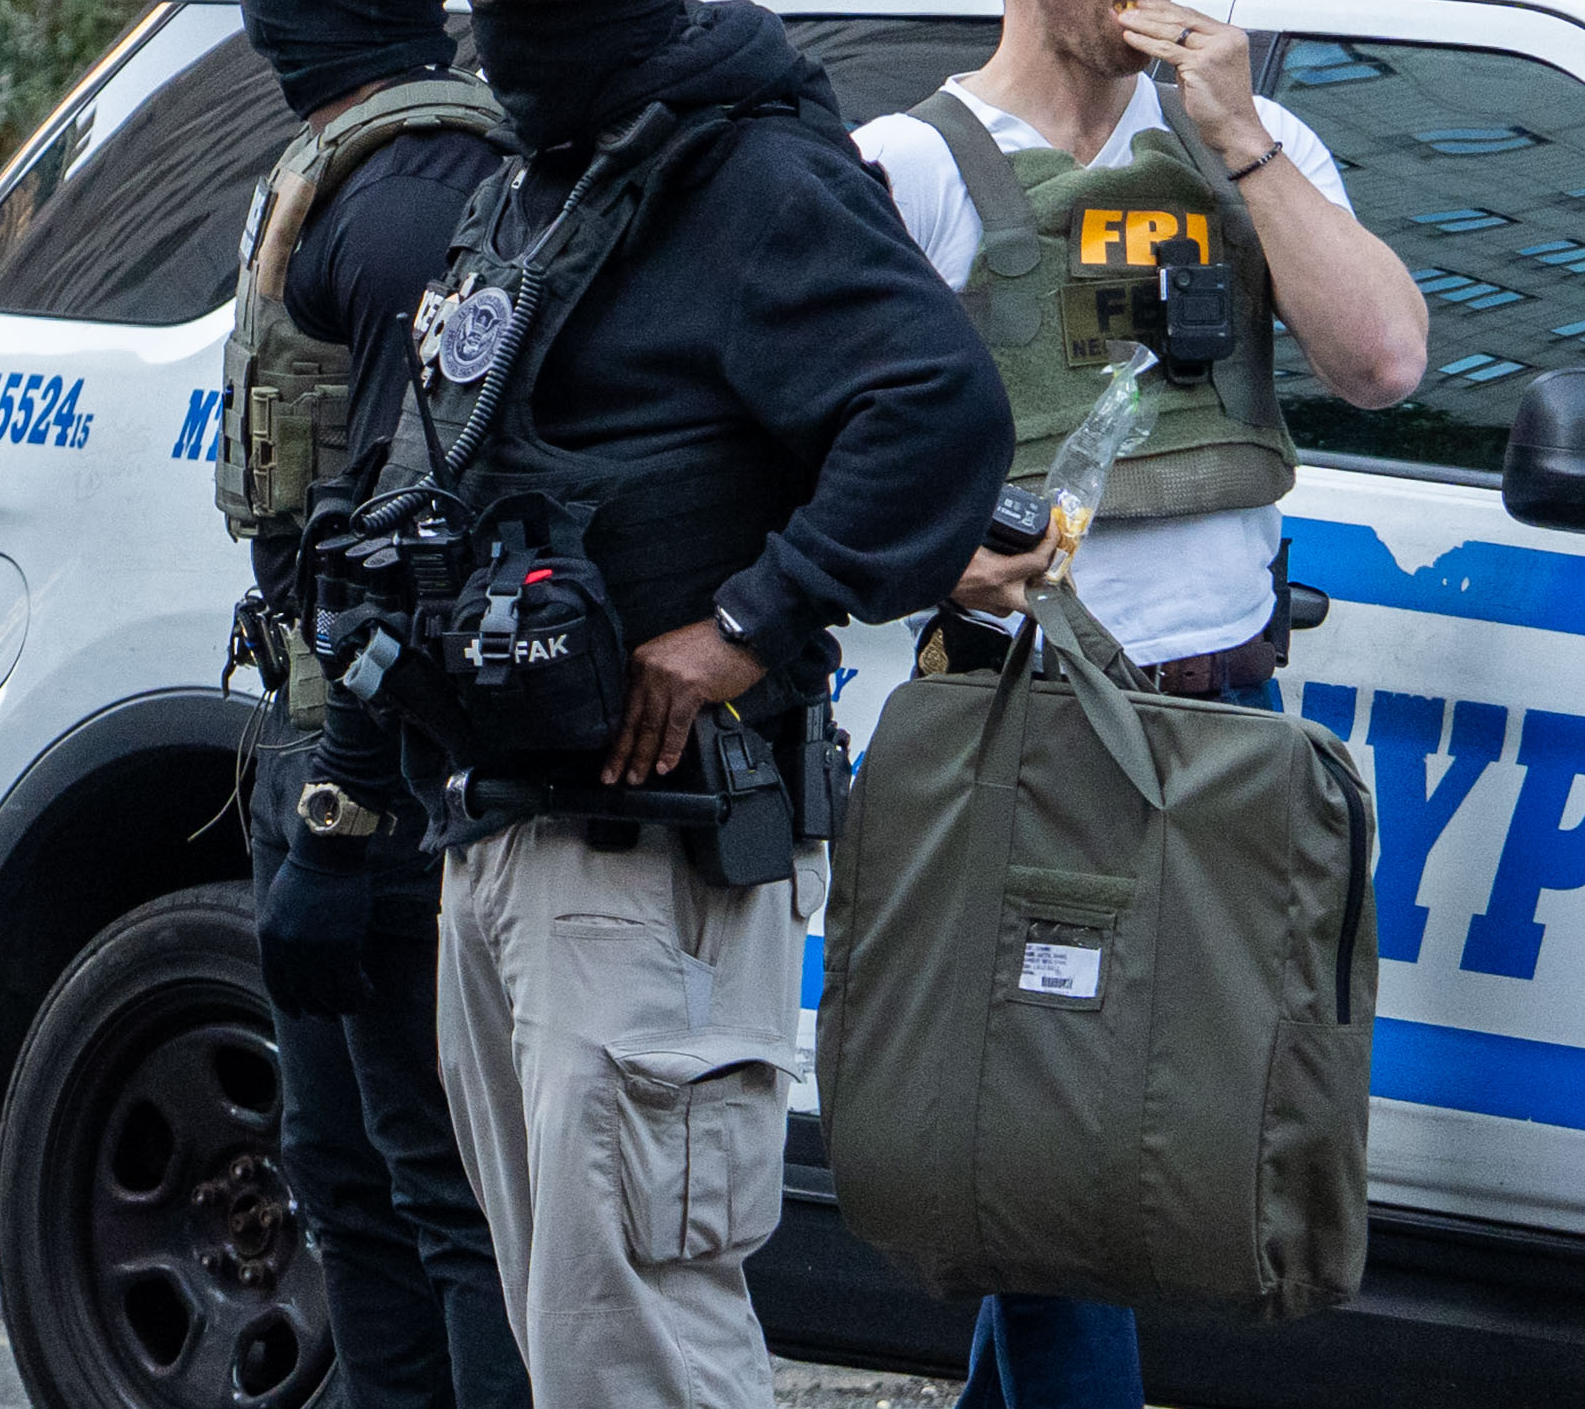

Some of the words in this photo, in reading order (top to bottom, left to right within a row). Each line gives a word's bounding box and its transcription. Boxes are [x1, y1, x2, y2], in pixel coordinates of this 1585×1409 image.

[1081, 209, 1209, 265] FBI
[69, 413, 94, 449] 15
[1301, 681, 1585, 981] YP
